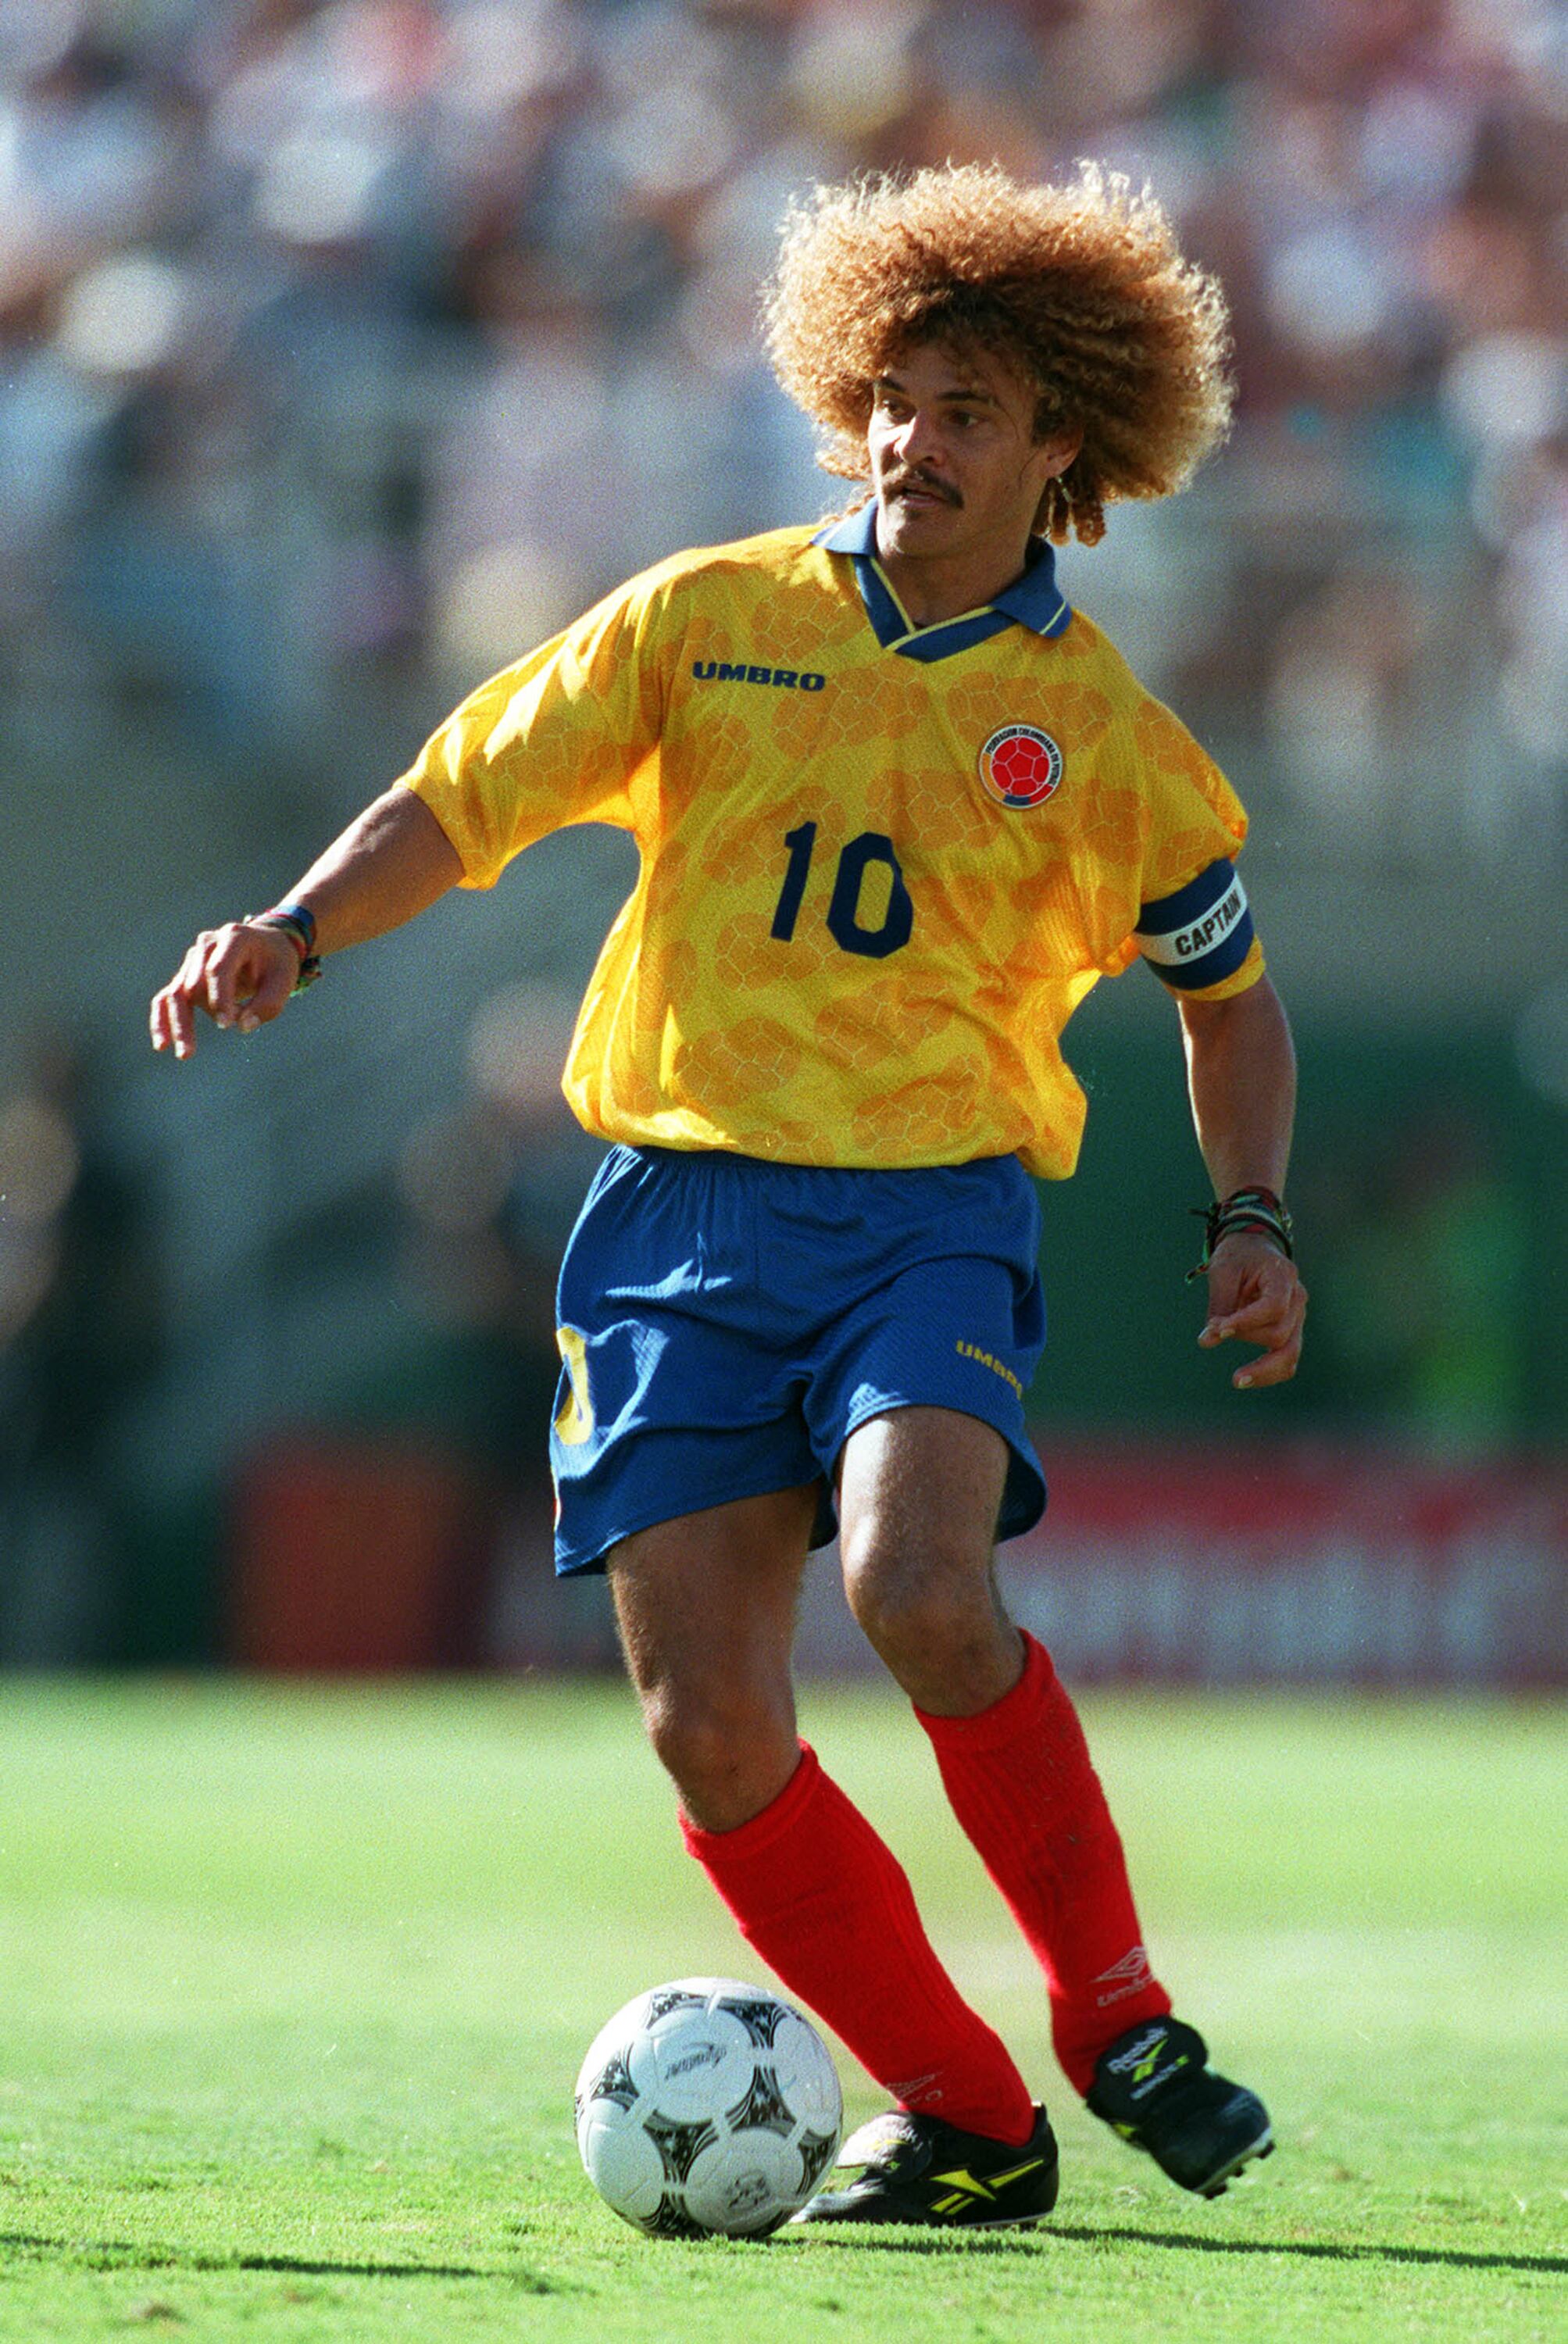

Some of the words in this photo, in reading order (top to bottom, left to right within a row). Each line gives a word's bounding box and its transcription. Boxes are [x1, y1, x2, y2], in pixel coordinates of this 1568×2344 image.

[692, 661, 826, 691] UMBRO
[770, 821, 914, 959] 10
[1174, 888, 1241, 956] CAPTAIN
